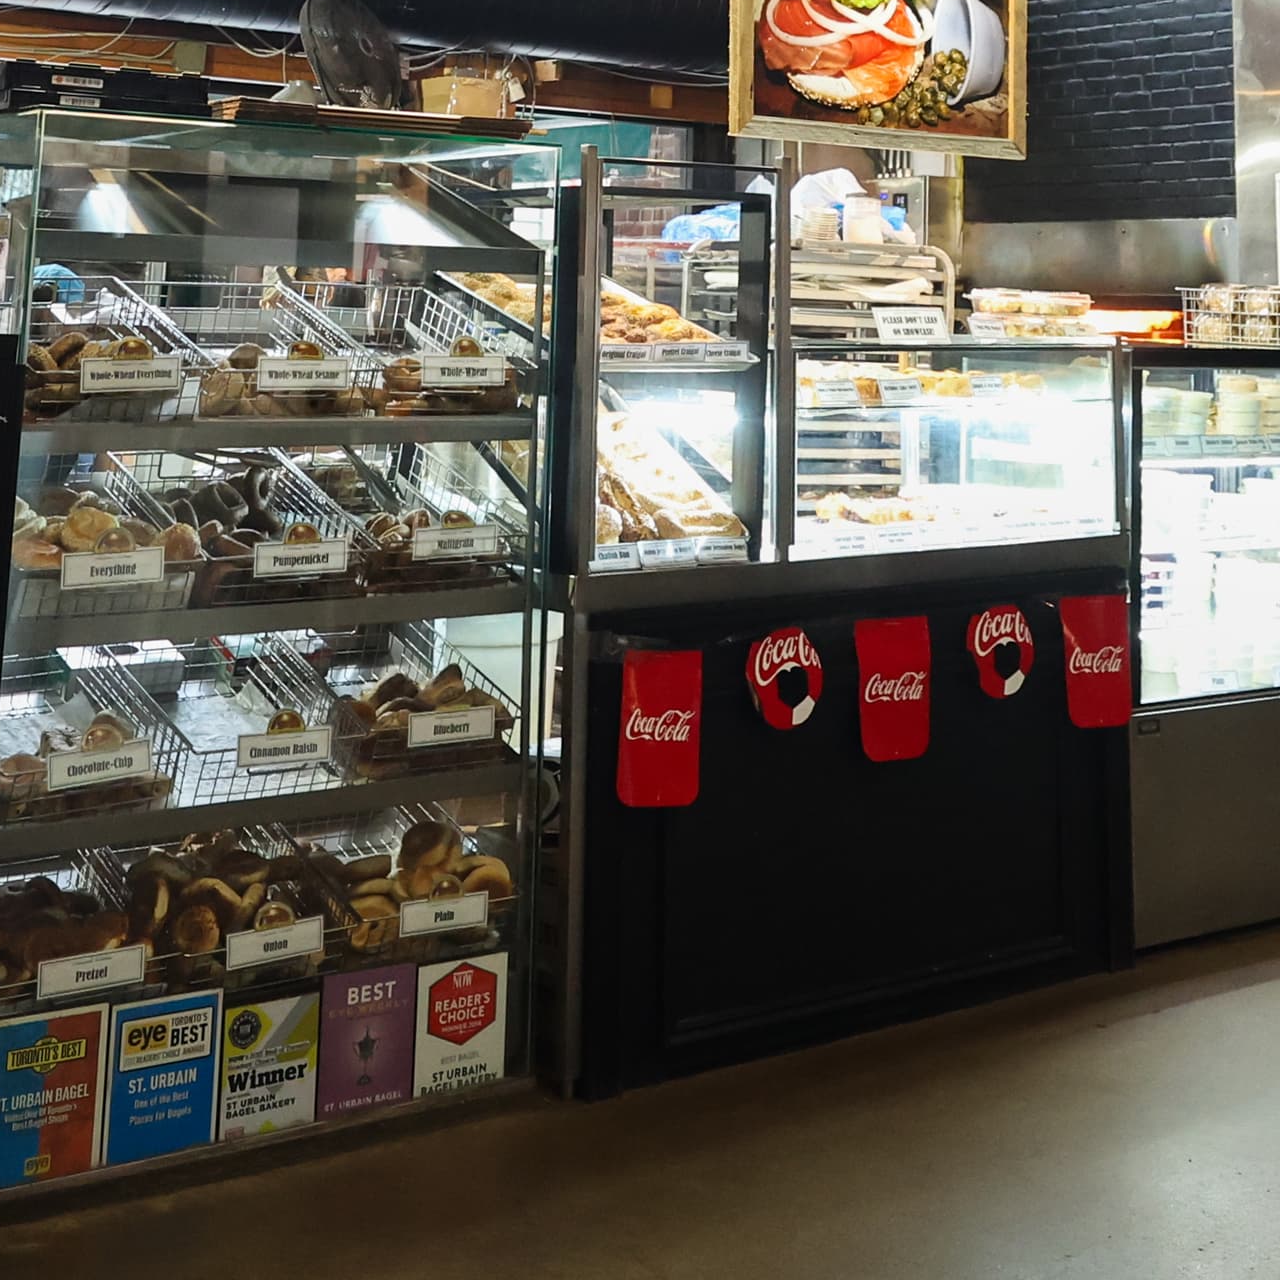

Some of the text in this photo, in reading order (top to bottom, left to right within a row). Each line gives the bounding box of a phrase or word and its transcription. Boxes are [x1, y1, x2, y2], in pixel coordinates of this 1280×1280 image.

[882, 315, 904, 325] PLEASE
[90, 369, 172, 381] Whole-Wheat Everything
[268, 370, 340, 380] Whole-Wheat Sesame
[440, 367, 488, 377] Whole-Wheat
[437, 538, 474, 550] Multigrain
[272, 553, 329, 567] Pumpernickel
[90, 563, 137, 577] Everything
[1068, 645, 1125, 675] Coca-Cola
[864, 670, 928, 704] Coca-Cola
[433, 722, 470, 736] Blueberry
[624, 707, 696, 743] Coca-Cola
[249, 743, 318, 758] Cinnamon Raisin
[67, 755, 134, 777] Chocolate-Chip
[434, 910, 455, 923] Plain
[263, 939, 288, 952] Onion
[75, 965, 108, 983] Pretzel
[453, 970, 475, 989] NOW
[347, 980, 397, 1005] BEST
[434, 991, 491, 1014] READER'S
[171, 1012, 208, 1027] TORONTO'S
[438, 1005, 486, 1025] CHOICE
[128, 1023, 167, 1052] eye
[170, 1023, 209, 1048] BEST
[10, 1040, 83, 1068] TORONTO'S BEST
[128, 1067, 198, 1095] ST. URBAIN
[227, 1062, 308, 1094] Winner
[432, 1062, 488, 1084] ST URBAIN
[420, 1071, 498, 1097] BAGEL BAKERY
[11, 1088, 54, 1111] URBAIN
[55, 1082, 90, 1103] BAGEL
[159, 1093, 171, 1105] the
[172, 1089, 190, 1102] Best
[226, 1100, 238, 1111] ST
[240, 1094, 276, 1108] URBAIN
[338, 1095, 372, 1110] URBAIN
[374, 1089, 403, 1103] BAGEL
[154, 1109, 166, 1121] for
[167, 1105, 193, 1120] Bagels
[226, 1106, 257, 1120] BAGEL
[259, 1097, 296, 1113] BAKERY
